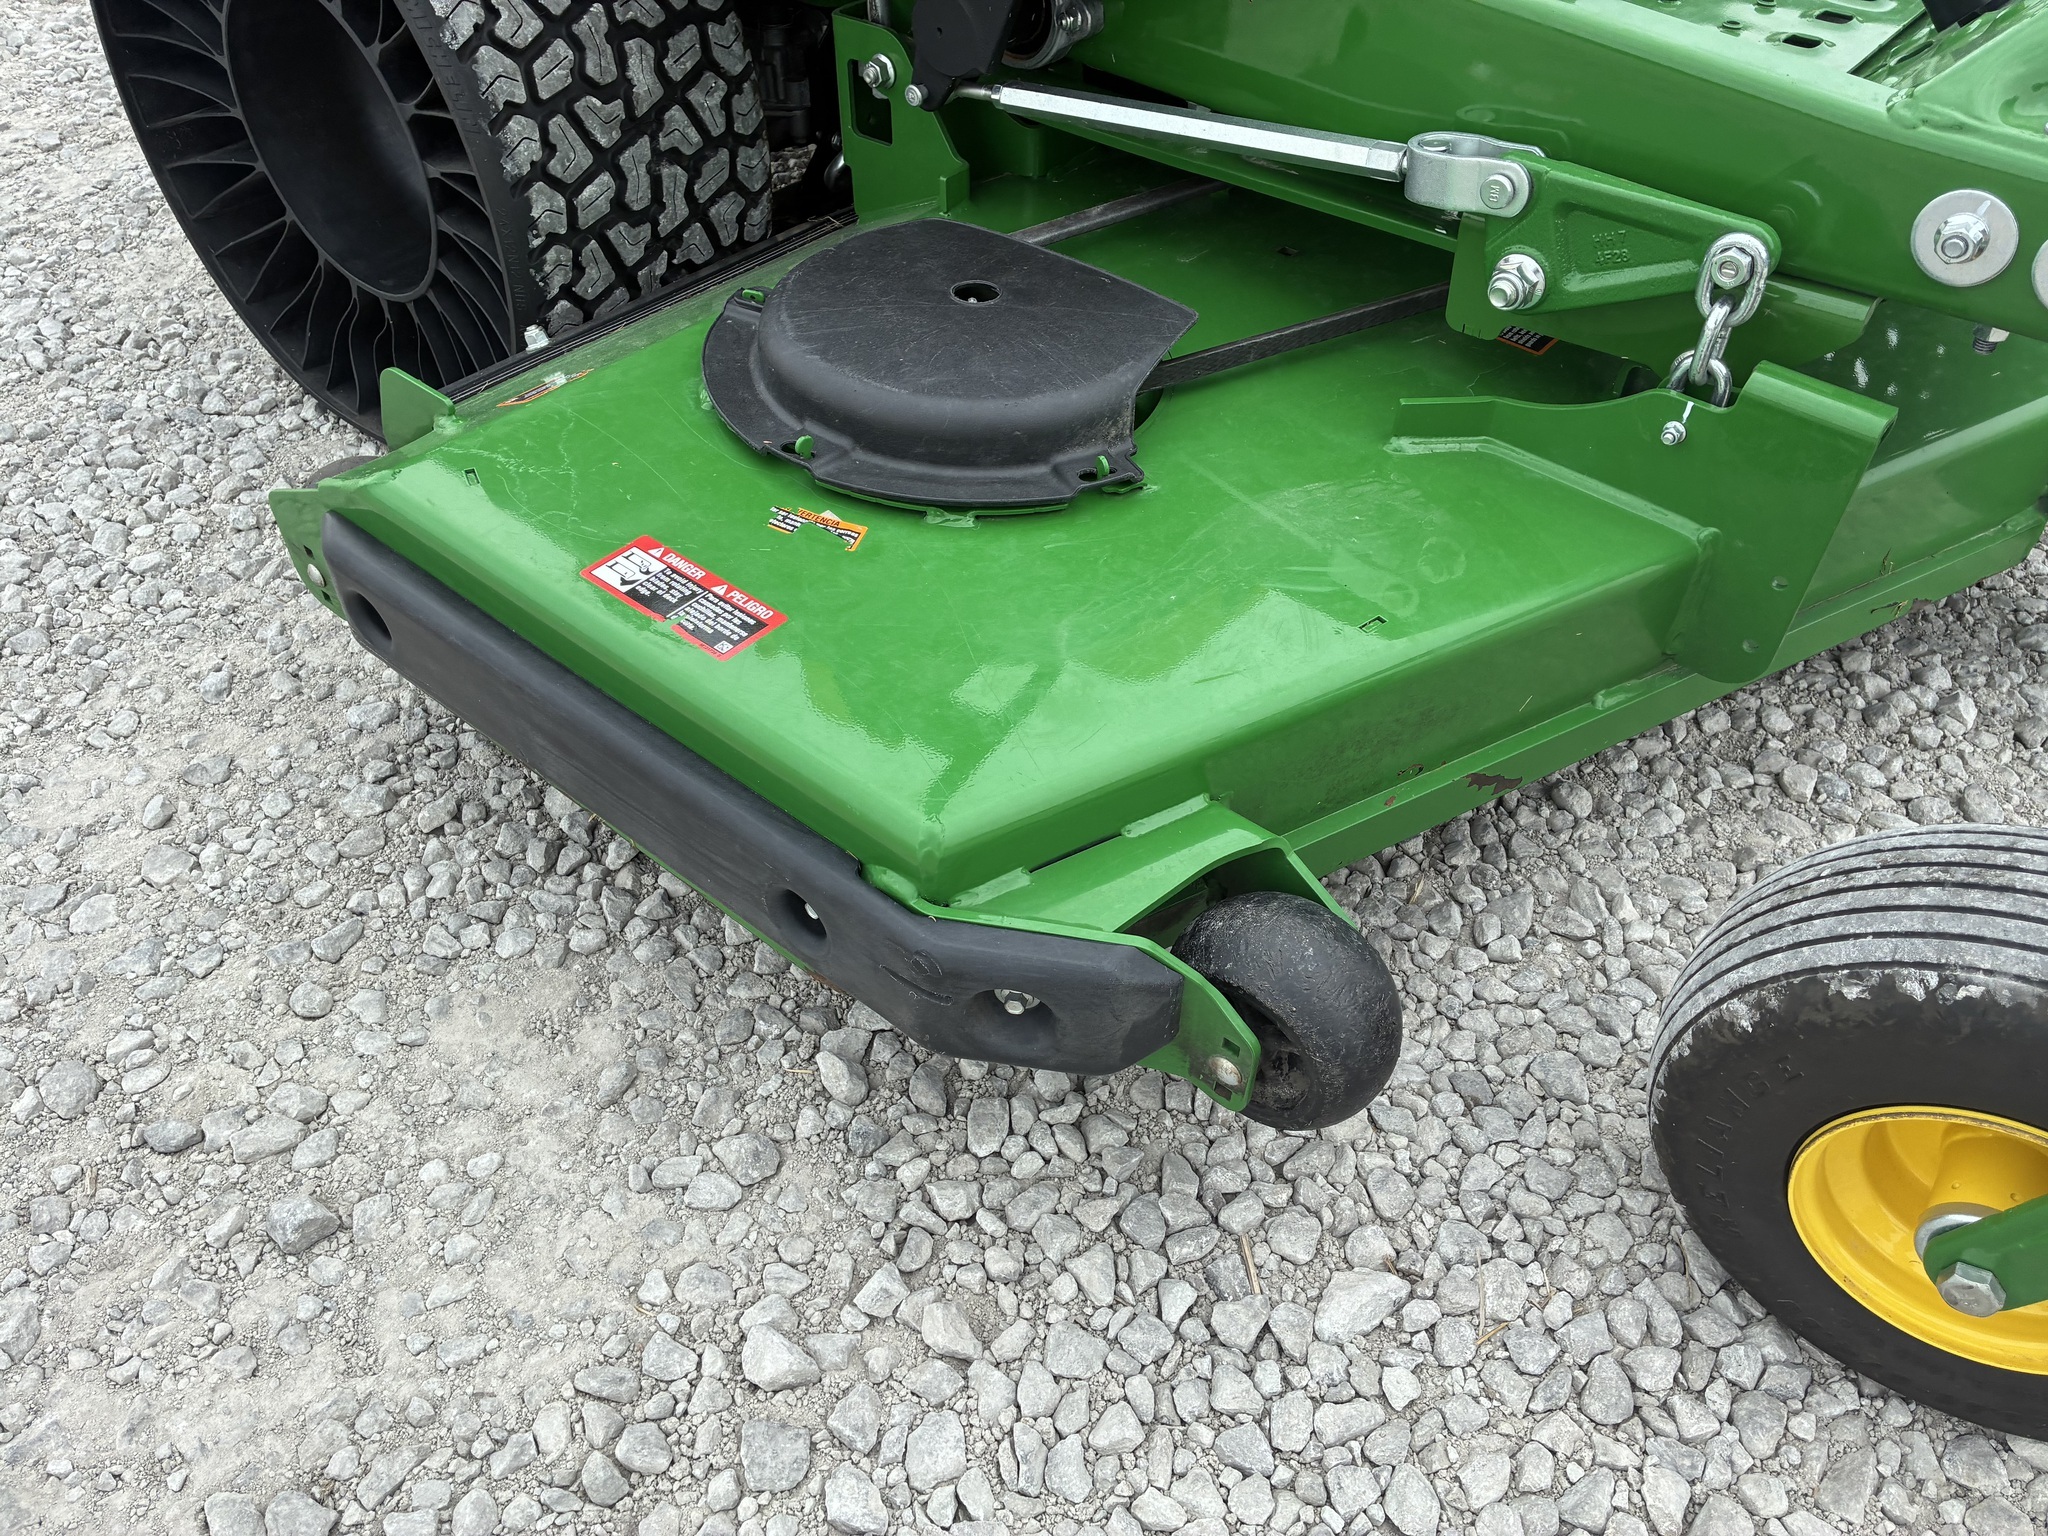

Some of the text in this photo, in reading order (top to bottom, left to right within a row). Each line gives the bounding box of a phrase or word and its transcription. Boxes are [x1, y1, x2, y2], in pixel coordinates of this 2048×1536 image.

[798, 509, 840, 527] VERTENCIA
[661, 552, 706, 580] DANGER
[642, 580, 659, 591] clear
[662, 593, 678, 604] deck
[655, 572, 692, 596] from rotating
[663, 567, 704, 594] To avoid injury
[668, 588, 684, 599] stay
[697, 597, 742, 625] causadas por las
[704, 592, 757, 625] Para evitar lesiones
[725, 590, 774, 619] PELIGRO
[683, 606, 707, 621] alejado
[704, 618, 717, 627] del
[713, 623, 732, 636] borde
[715, 616, 749, 637] mantenerse
